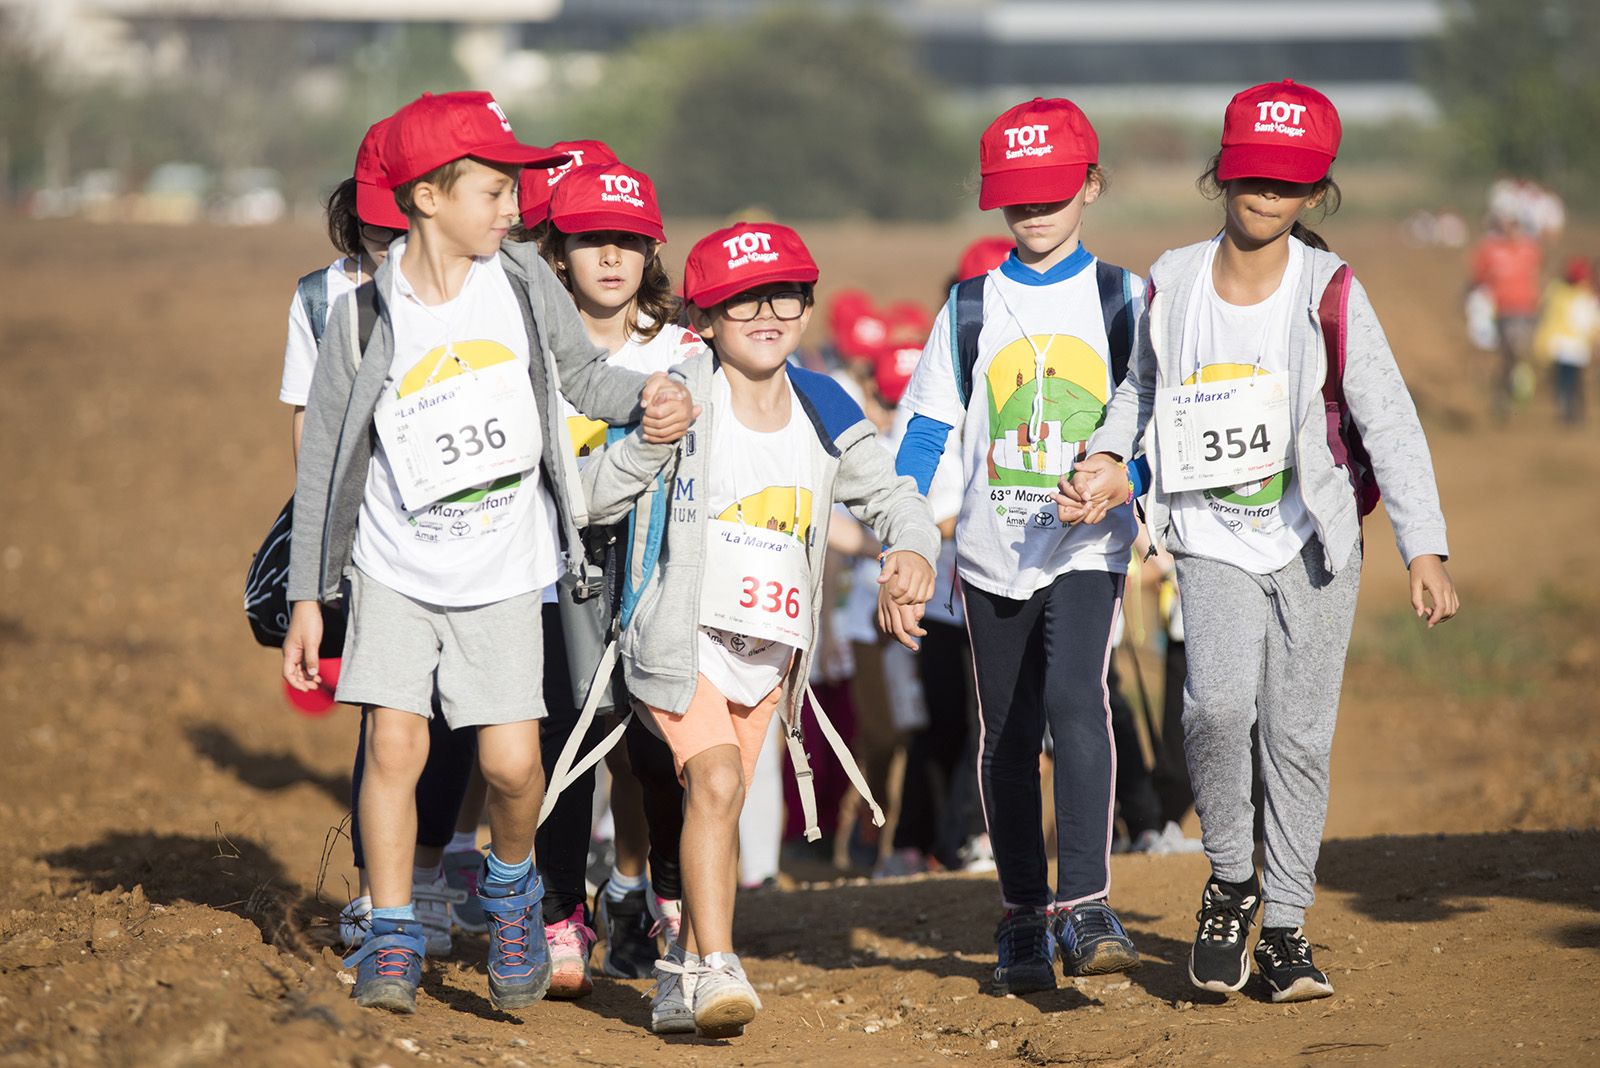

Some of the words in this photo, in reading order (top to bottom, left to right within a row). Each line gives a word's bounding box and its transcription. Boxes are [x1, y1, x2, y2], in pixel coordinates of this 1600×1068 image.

[1256, 101, 1307, 125] TOT
[1004, 124, 1049, 148] TOT
[599, 174, 641, 197] TOT
[722, 231, 772, 259] TOT
[435, 417, 506, 466] 336
[1202, 424, 1271, 462] 354
[672, 507, 697, 523] IUM
[739, 576, 800, 619] 336
